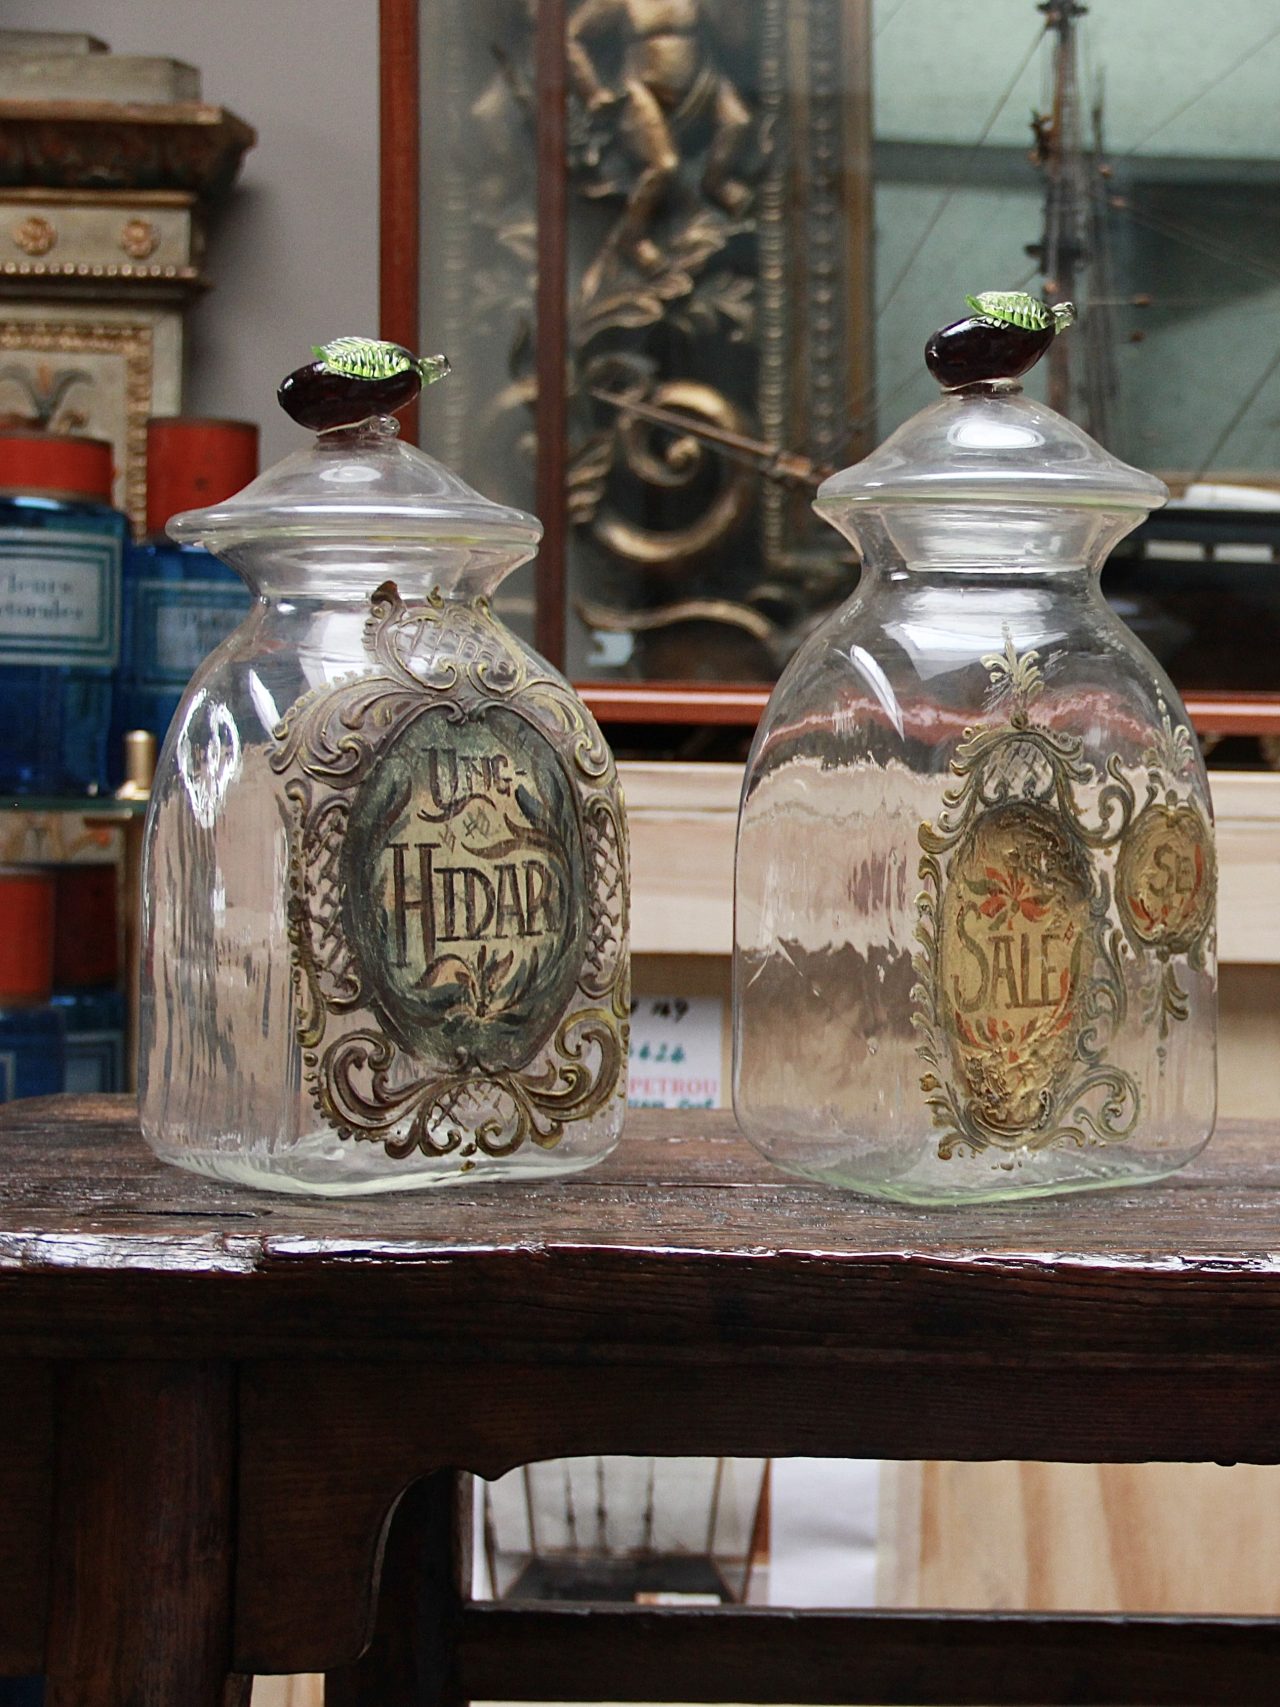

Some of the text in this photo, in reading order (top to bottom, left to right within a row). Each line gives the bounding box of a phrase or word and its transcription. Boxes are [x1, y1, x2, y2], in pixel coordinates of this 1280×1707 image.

[387, 841, 563, 970] HIDAR
[951, 900, 1065, 1014] SALE
[629, 1077, 718, 1096] PETROU
